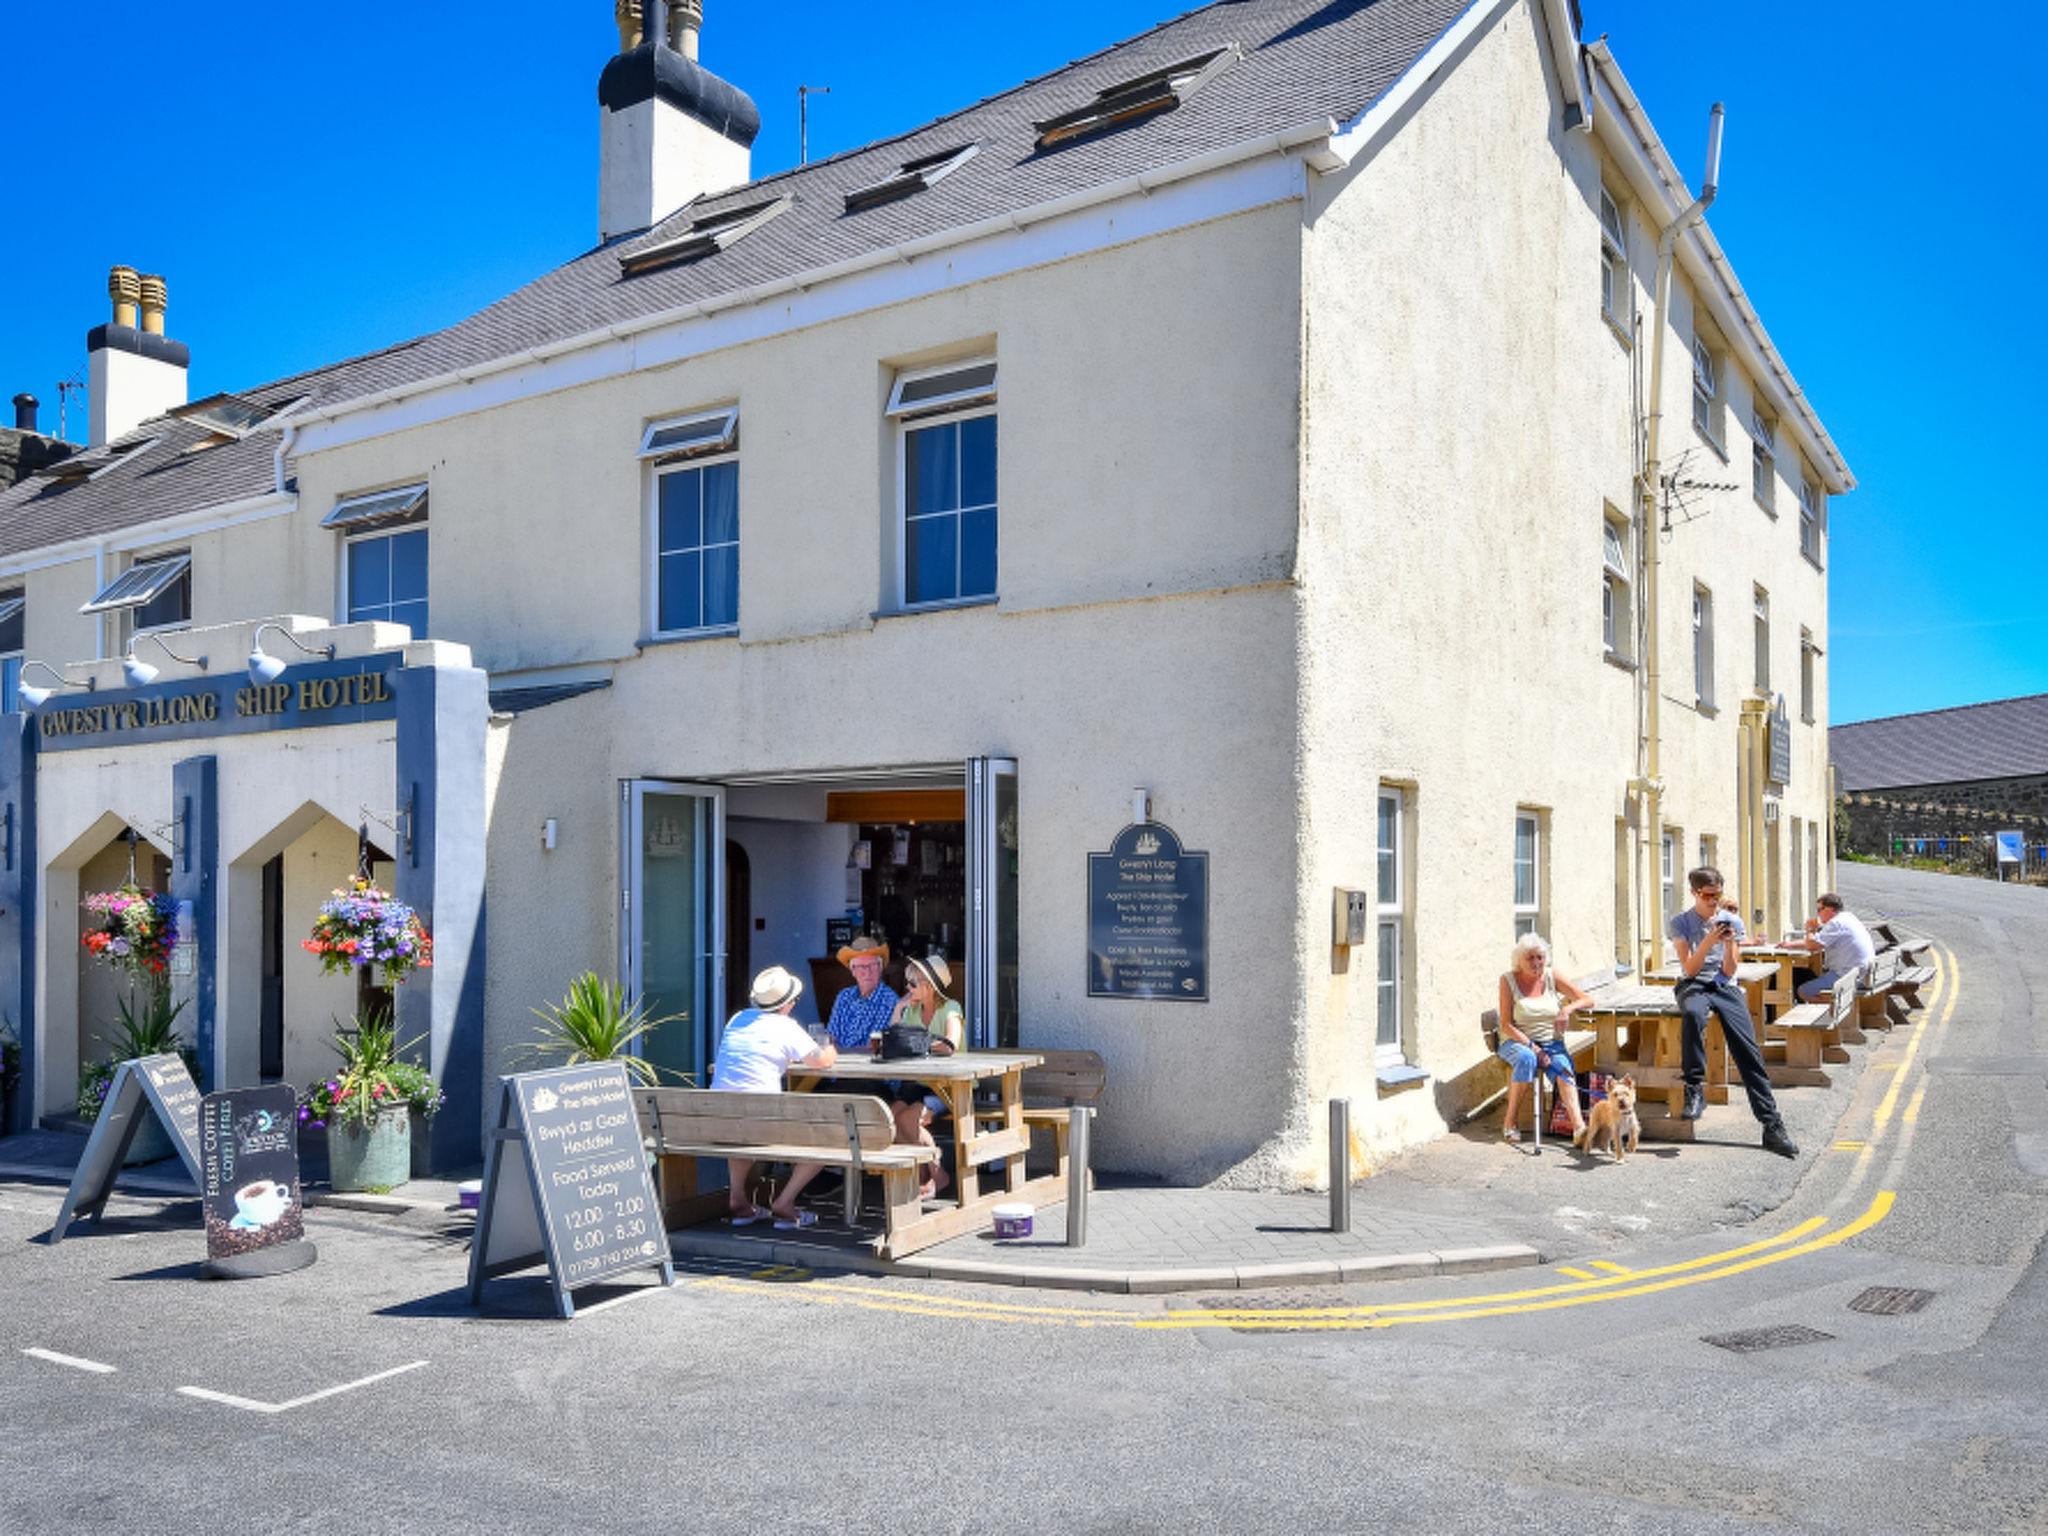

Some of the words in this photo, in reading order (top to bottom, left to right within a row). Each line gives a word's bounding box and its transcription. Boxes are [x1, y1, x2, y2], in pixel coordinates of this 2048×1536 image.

[40, 702, 139, 736] GWESTY'R
[145, 693, 217, 727] LLONG
[235, 682, 290, 717] SHIP
[298, 671, 390, 711] HOTEL
[204, 1102, 218, 1152] COFFEE
[539, 1119, 577, 1141] Bwyd
[206, 1155, 220, 1197] FRESH
[552, 1165, 588, 1187] Food
[590, 1155, 636, 1179] Served
[578, 1181, 619, 1200] Today
[564, 1205, 603, 1231] 12.00
[614, 1196, 644, 1218] 2.00
[573, 1228, 605, 1252] 6.00
[614, 1218, 646, 1241] 8.30
